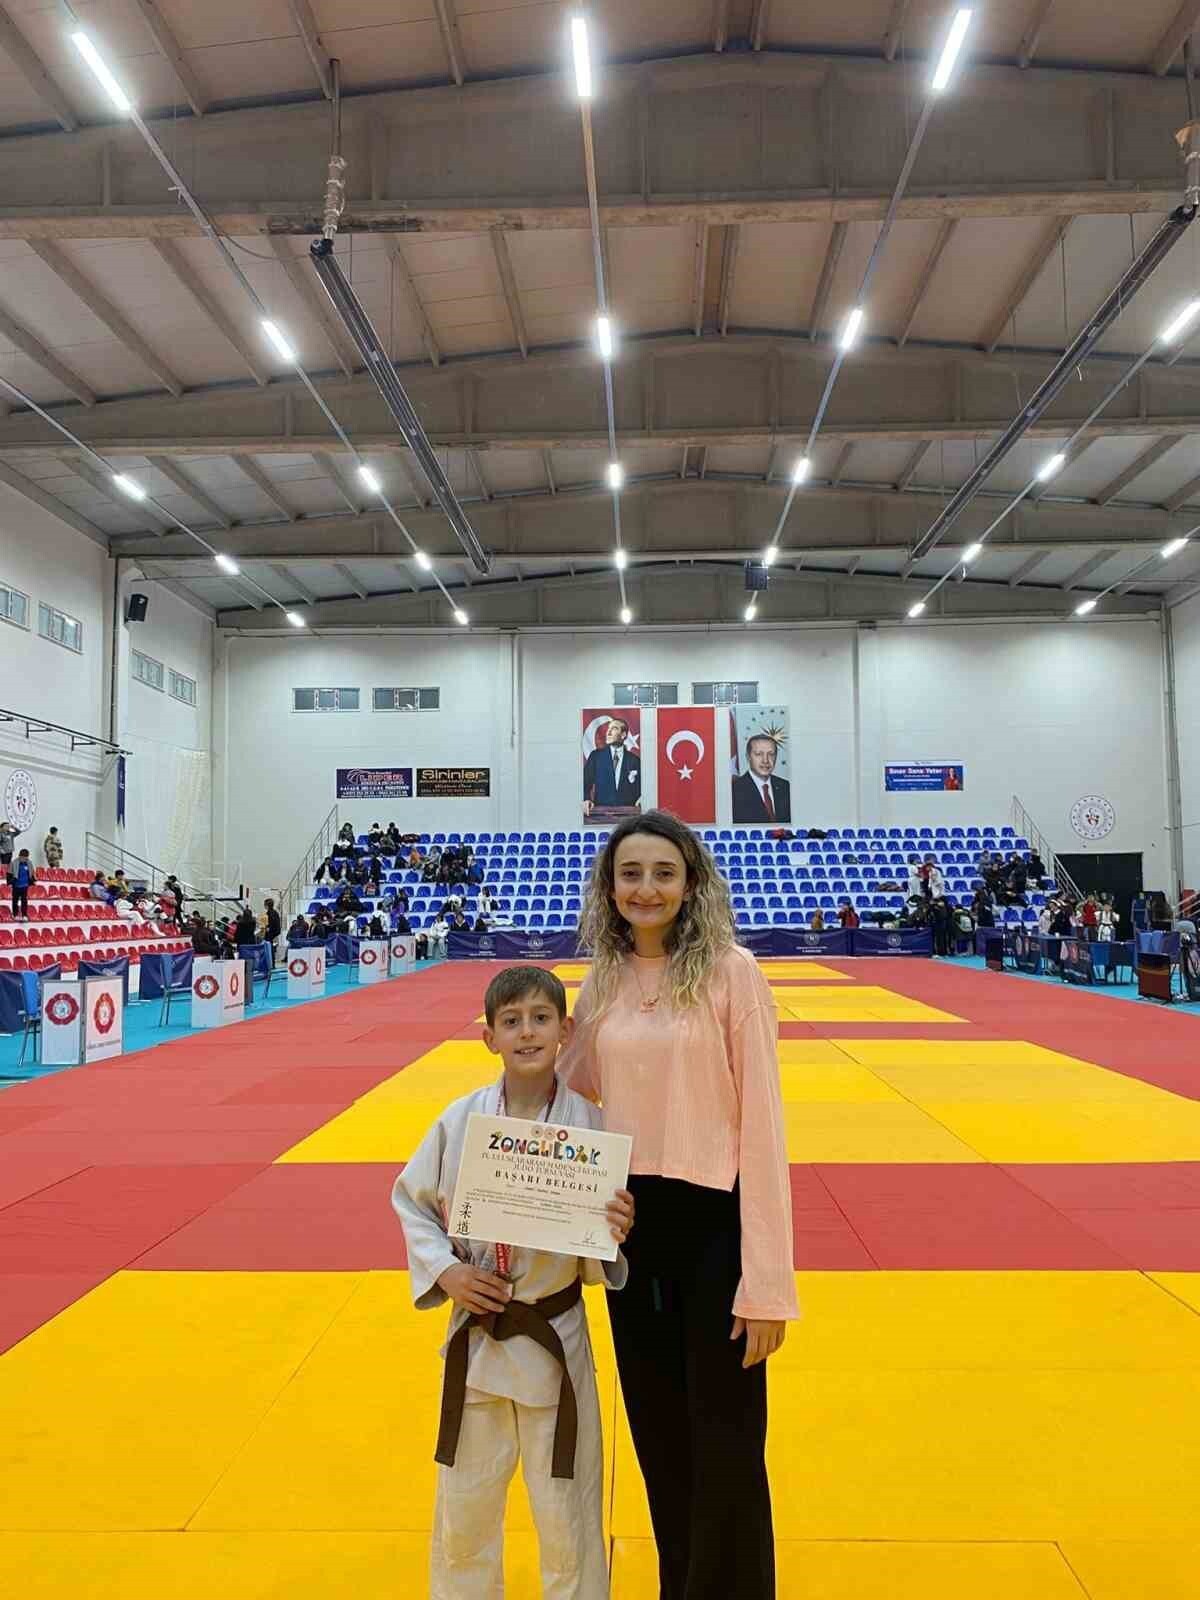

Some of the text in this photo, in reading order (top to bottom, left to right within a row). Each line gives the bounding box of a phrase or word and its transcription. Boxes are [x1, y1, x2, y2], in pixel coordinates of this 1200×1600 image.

[488, 1132, 601, 1166] ZONGULDAK
[495, 1170, 541, 1184] BAŞARI
[545, 1178, 598, 1193] BELGESİ
